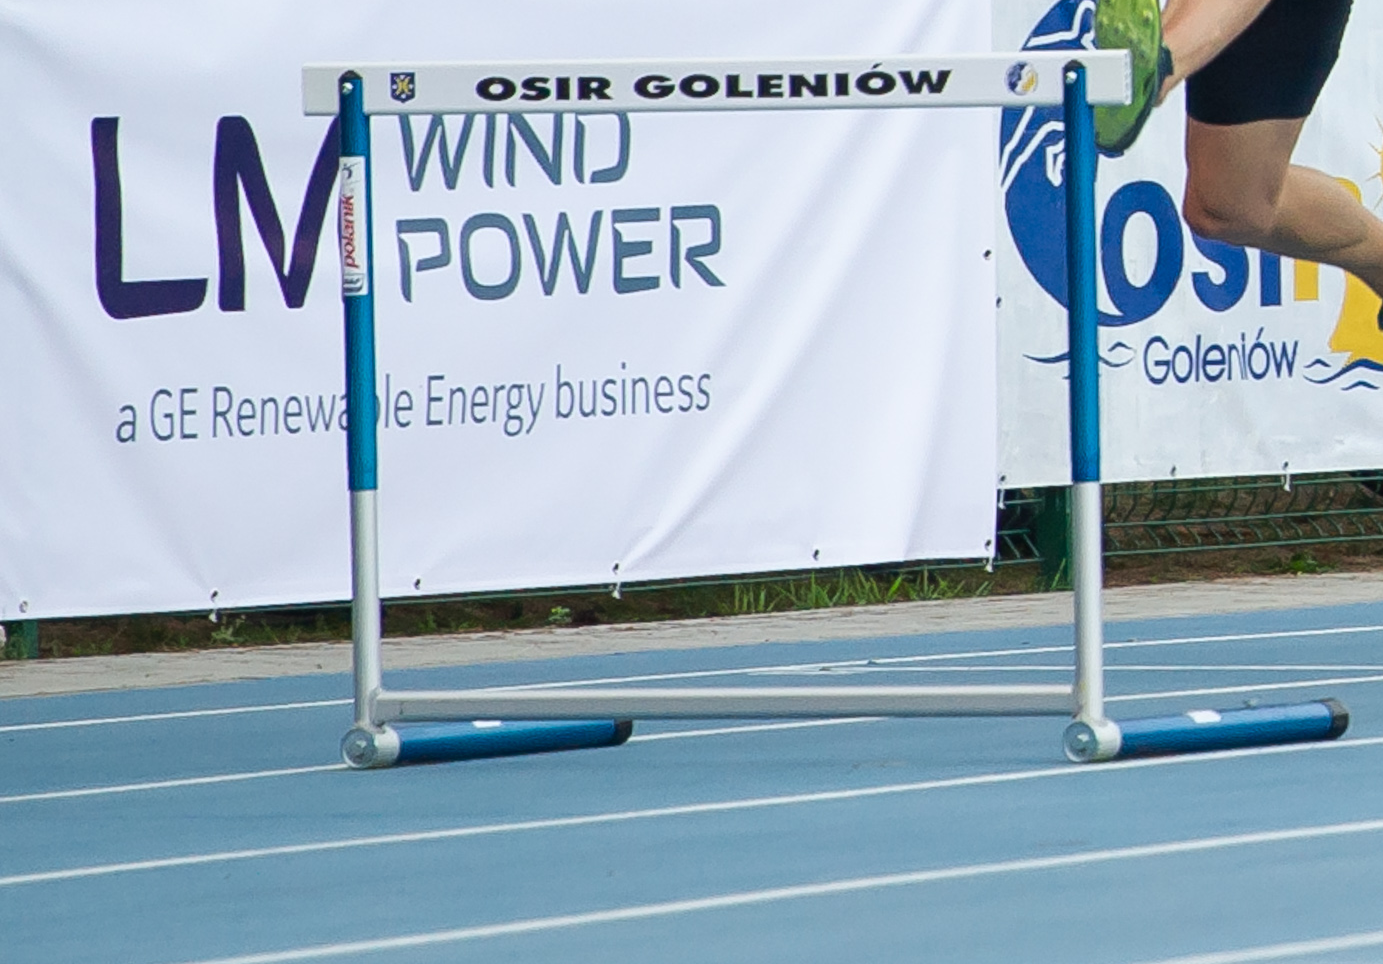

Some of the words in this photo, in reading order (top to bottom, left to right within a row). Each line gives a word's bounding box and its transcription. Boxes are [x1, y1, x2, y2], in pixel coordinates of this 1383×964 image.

[475, 76, 613, 102] OSIR
[633, 64, 952, 100] GOLENIÓW
[398, 112, 631, 192] WIND
[91, 115, 340, 320] LM
[395, 204, 727, 303] POWER
[1143, 326, 1299, 385] Goleniów
[115, 404, 137, 444] a
[150, 388, 199, 442] GE
[212, 373, 414, 438] Renewle
[425, 373, 546, 438] Energy
[555, 361, 712, 420] business
